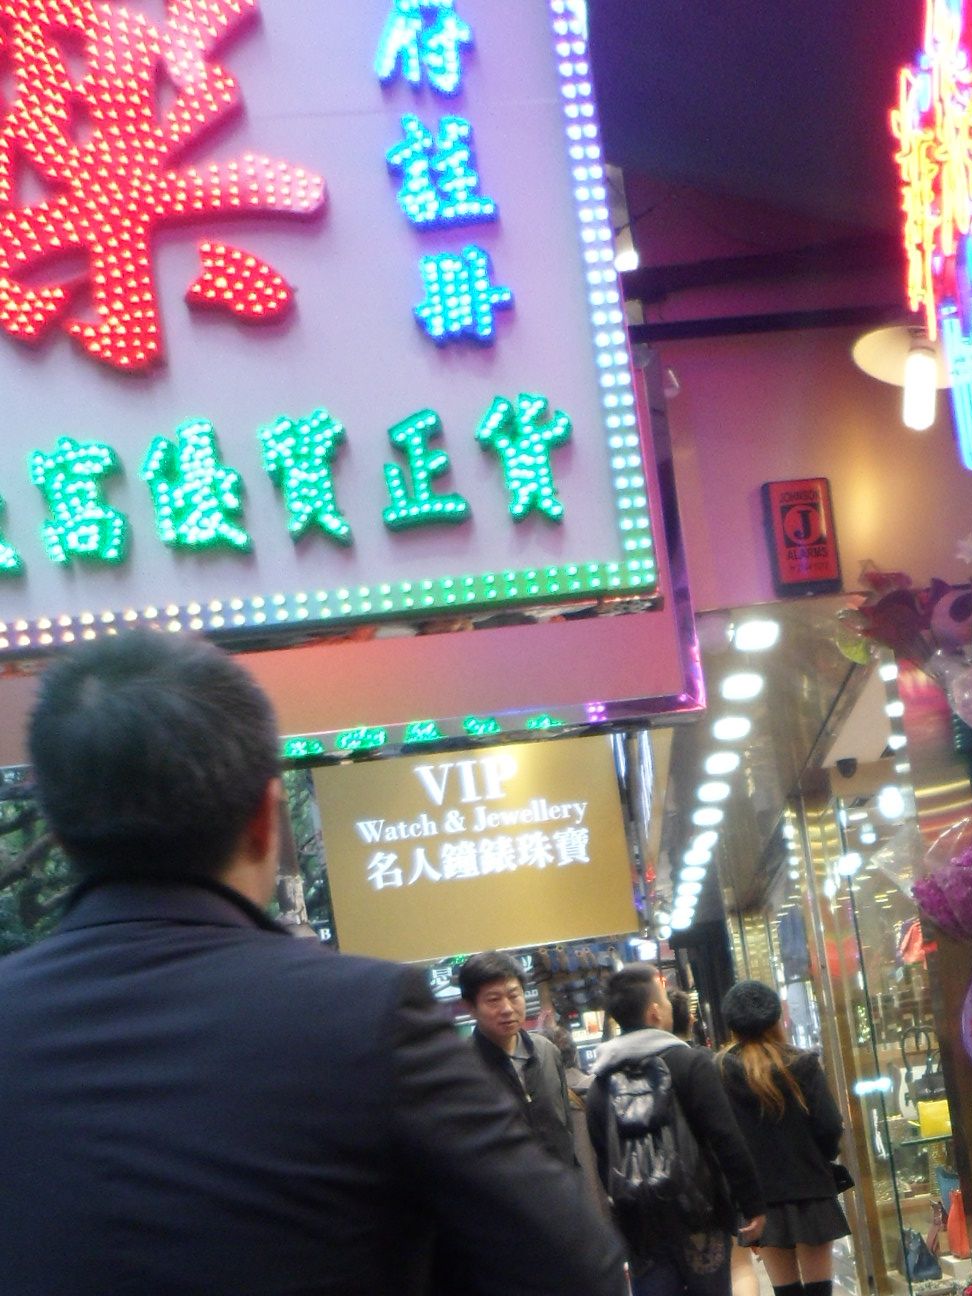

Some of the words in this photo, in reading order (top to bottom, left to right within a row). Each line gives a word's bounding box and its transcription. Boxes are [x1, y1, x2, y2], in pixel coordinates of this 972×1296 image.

[786, 545, 829, 561] ALARMS
[415, 754, 517, 806] VIP
[357, 814, 437, 843] Watch
[444, 809, 466, 833] &
[473, 799, 587, 832] Jewellery
